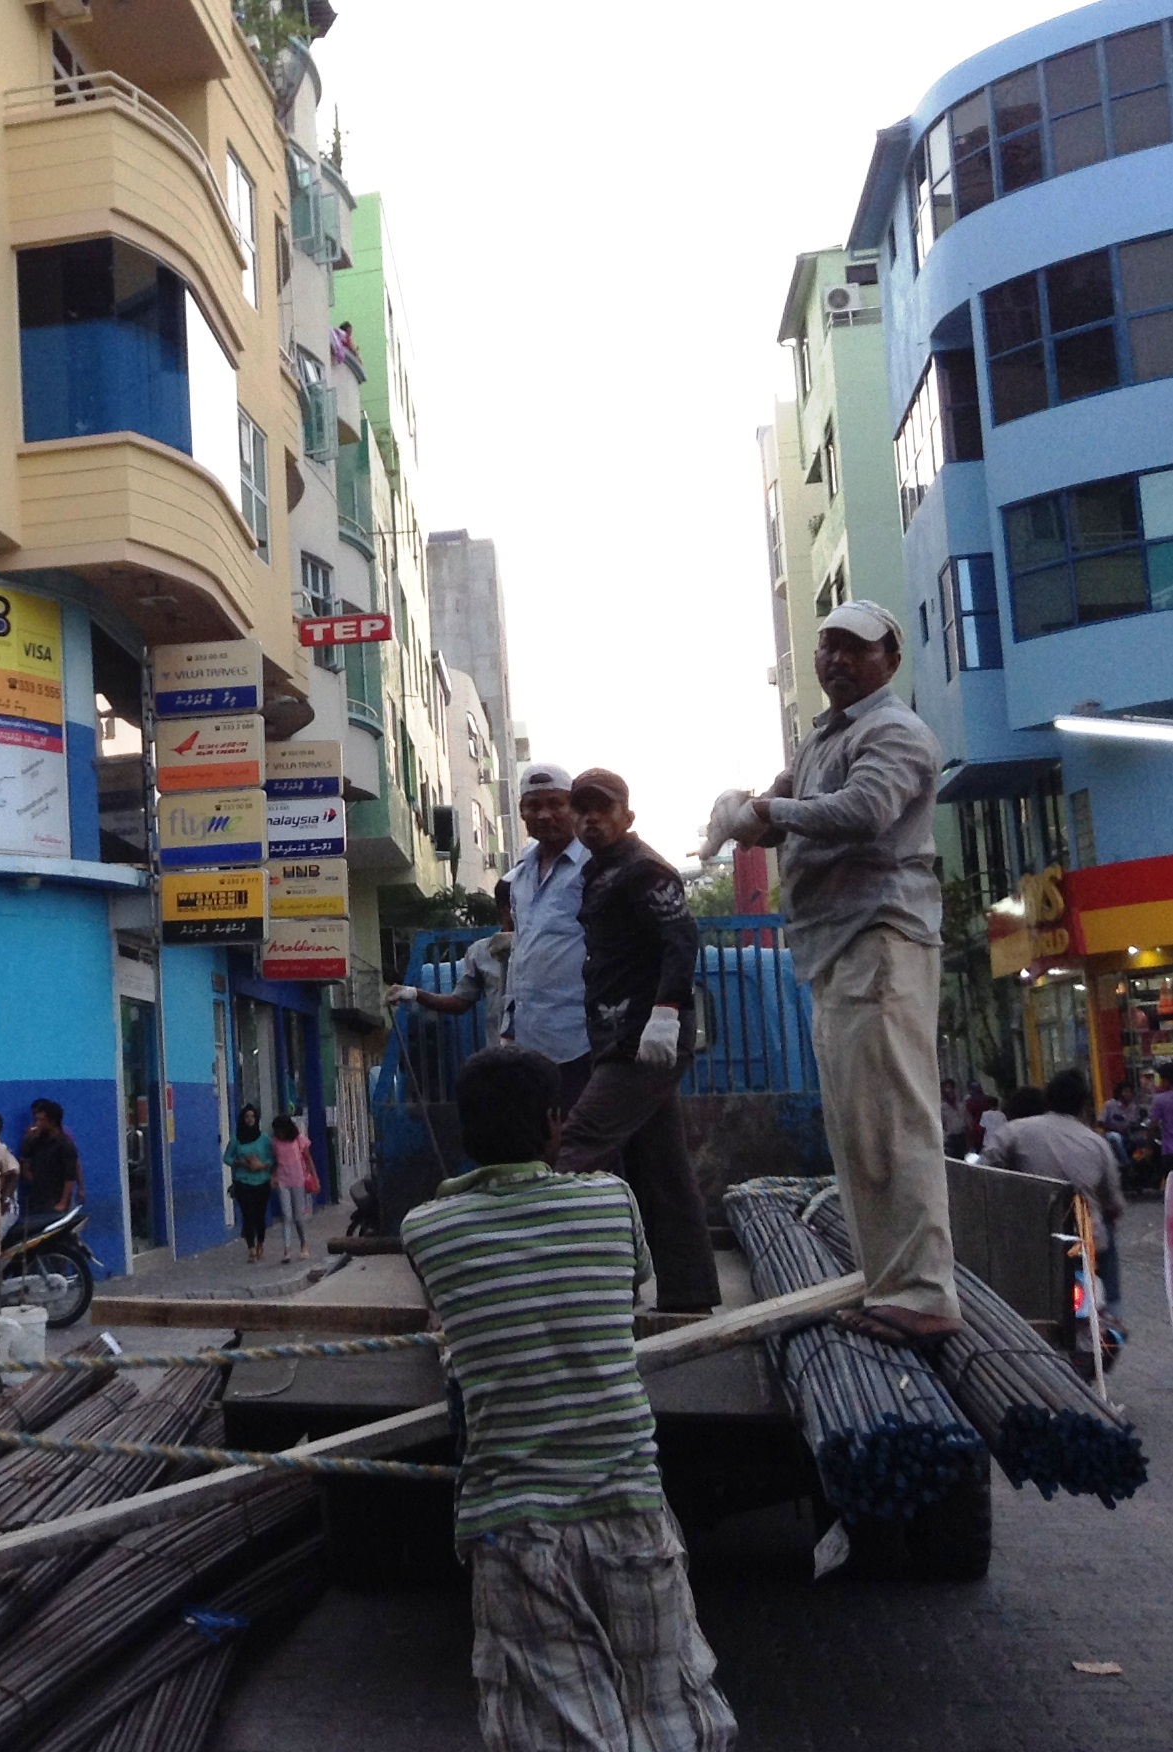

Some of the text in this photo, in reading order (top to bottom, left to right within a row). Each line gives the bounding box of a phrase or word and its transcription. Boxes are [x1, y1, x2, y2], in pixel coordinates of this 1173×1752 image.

[305, 619, 385, 641] TEP
[23, 643, 53, 661] VISA
[174, 667, 248, 680] VILLA TRAVELS
[273, 761, 333, 770] VILLA TRAVELS
[283, 865, 320, 878] HNB
[177, 891, 236, 900] WESTERN
[196, 898, 236, 907] UNION
